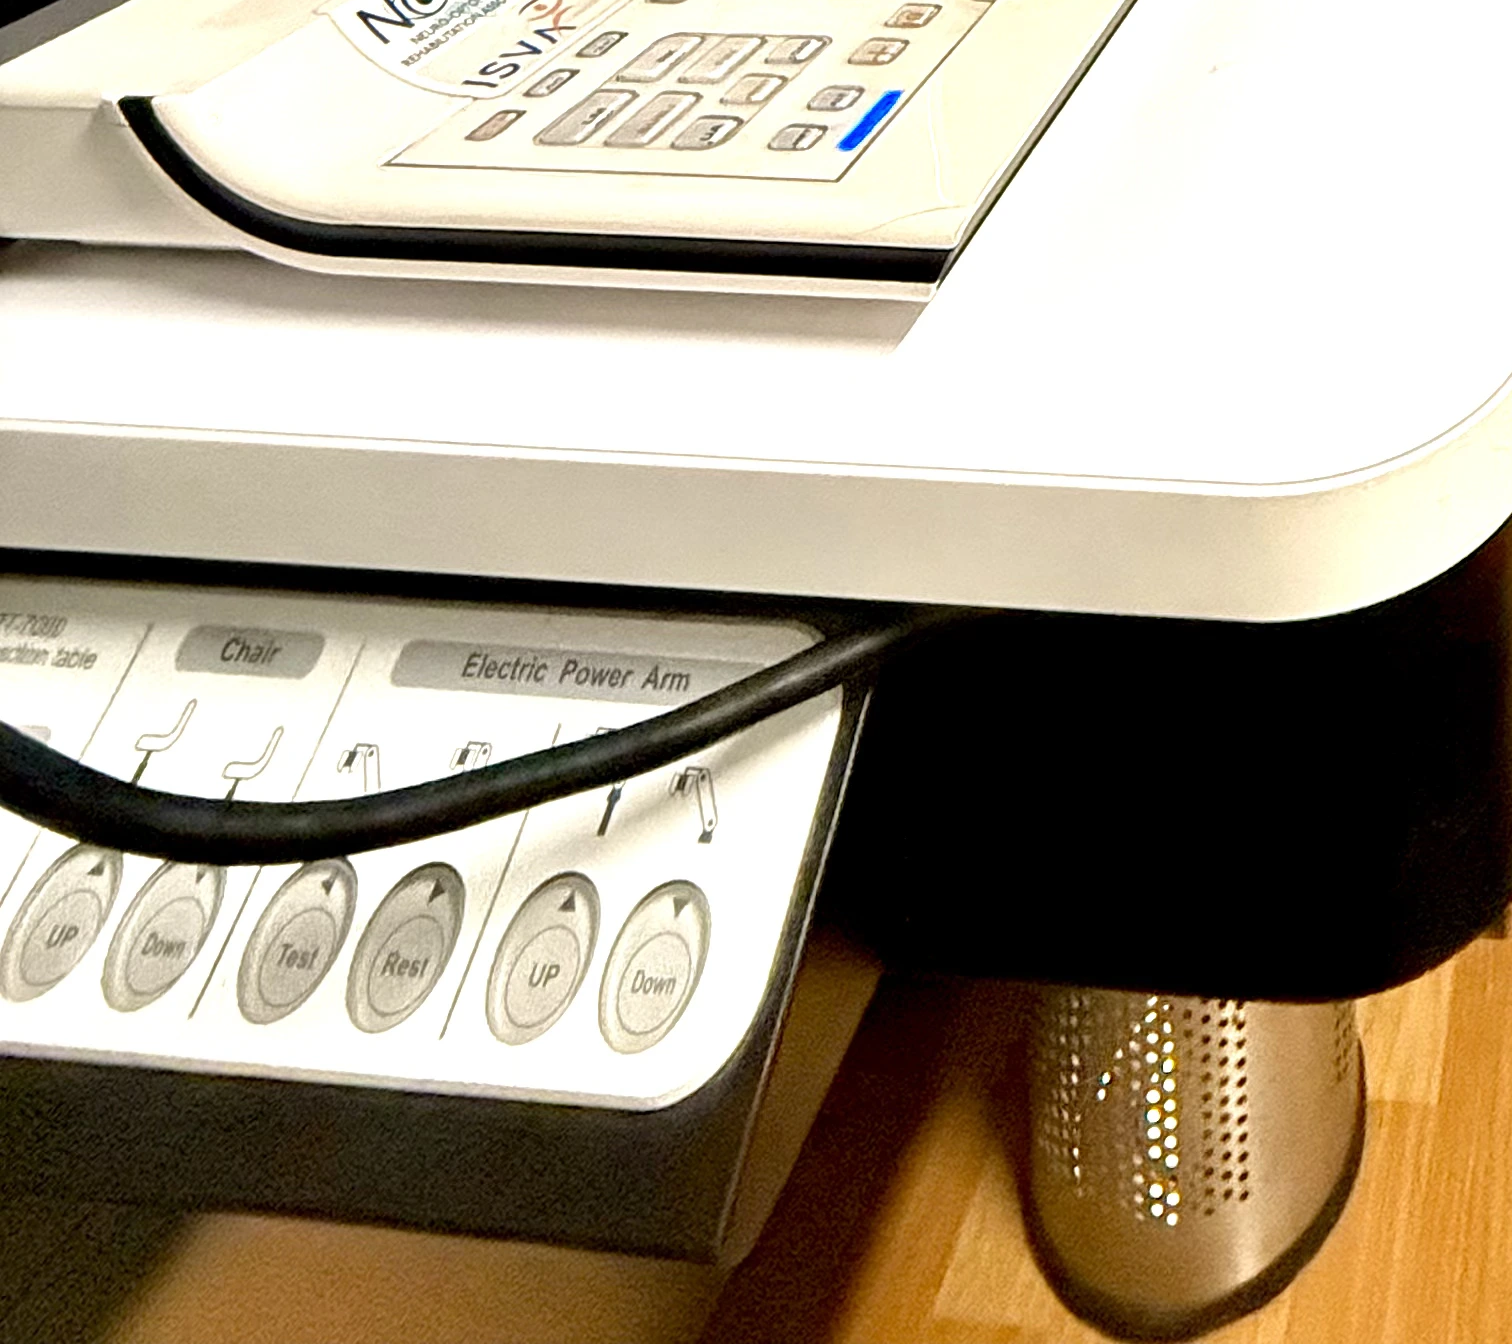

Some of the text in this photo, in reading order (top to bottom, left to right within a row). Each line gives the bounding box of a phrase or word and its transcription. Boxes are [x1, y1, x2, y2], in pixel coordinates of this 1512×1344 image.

[219, 637, 282, 666] Chair
[460, 651, 692, 692] Electric Power Arm
[45, 924, 80, 950] UP
[140, 931, 188, 961] Down
[275, 942, 320, 972] Test
[379, 950, 430, 979] Rest
[527, 962, 561, 988] UP
[630, 968, 677, 996] Down
